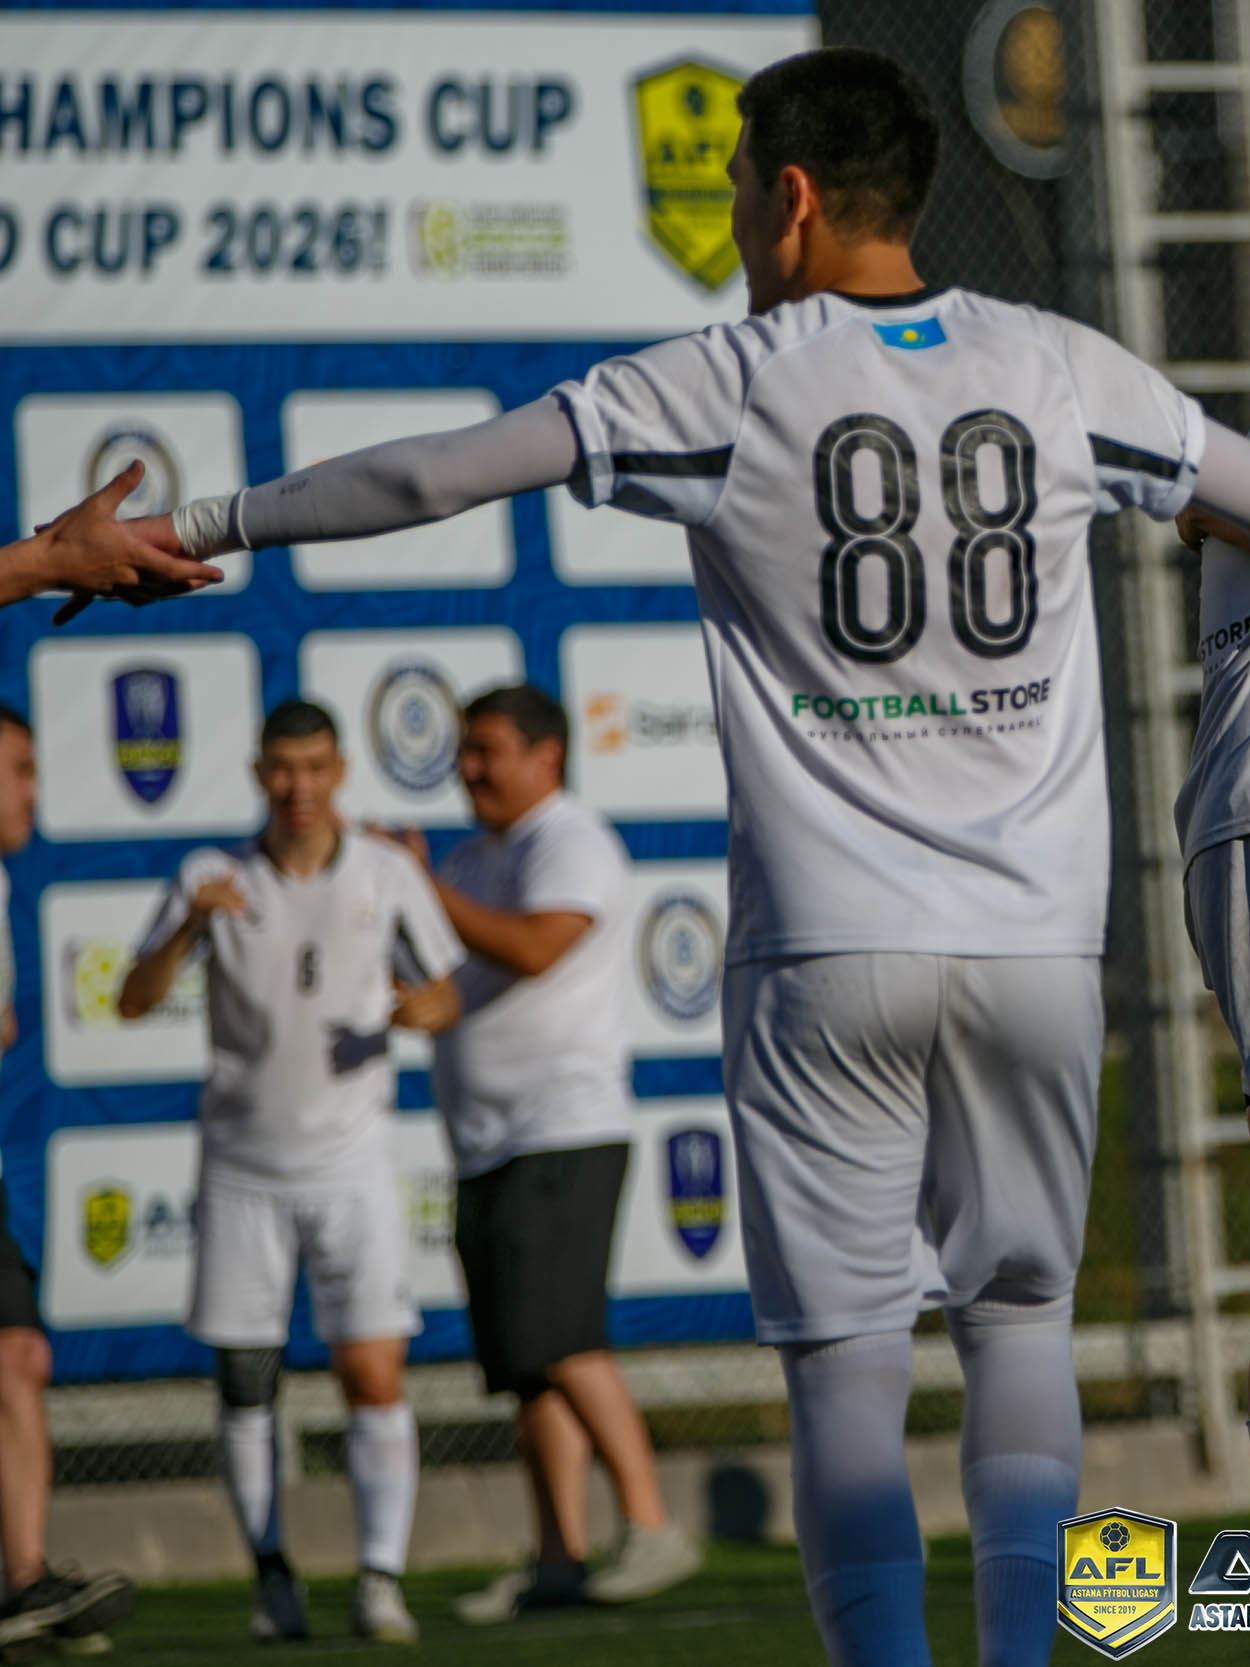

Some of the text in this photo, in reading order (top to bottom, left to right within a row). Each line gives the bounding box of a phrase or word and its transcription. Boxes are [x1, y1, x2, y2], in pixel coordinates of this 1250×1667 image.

[0, 73, 574, 156] HAMPIONS CUP
[45, 208, 180, 274] CUP
[812, 407, 1039, 664] 88
[938, 717, 1042, 737] СУПЕРМАРК
